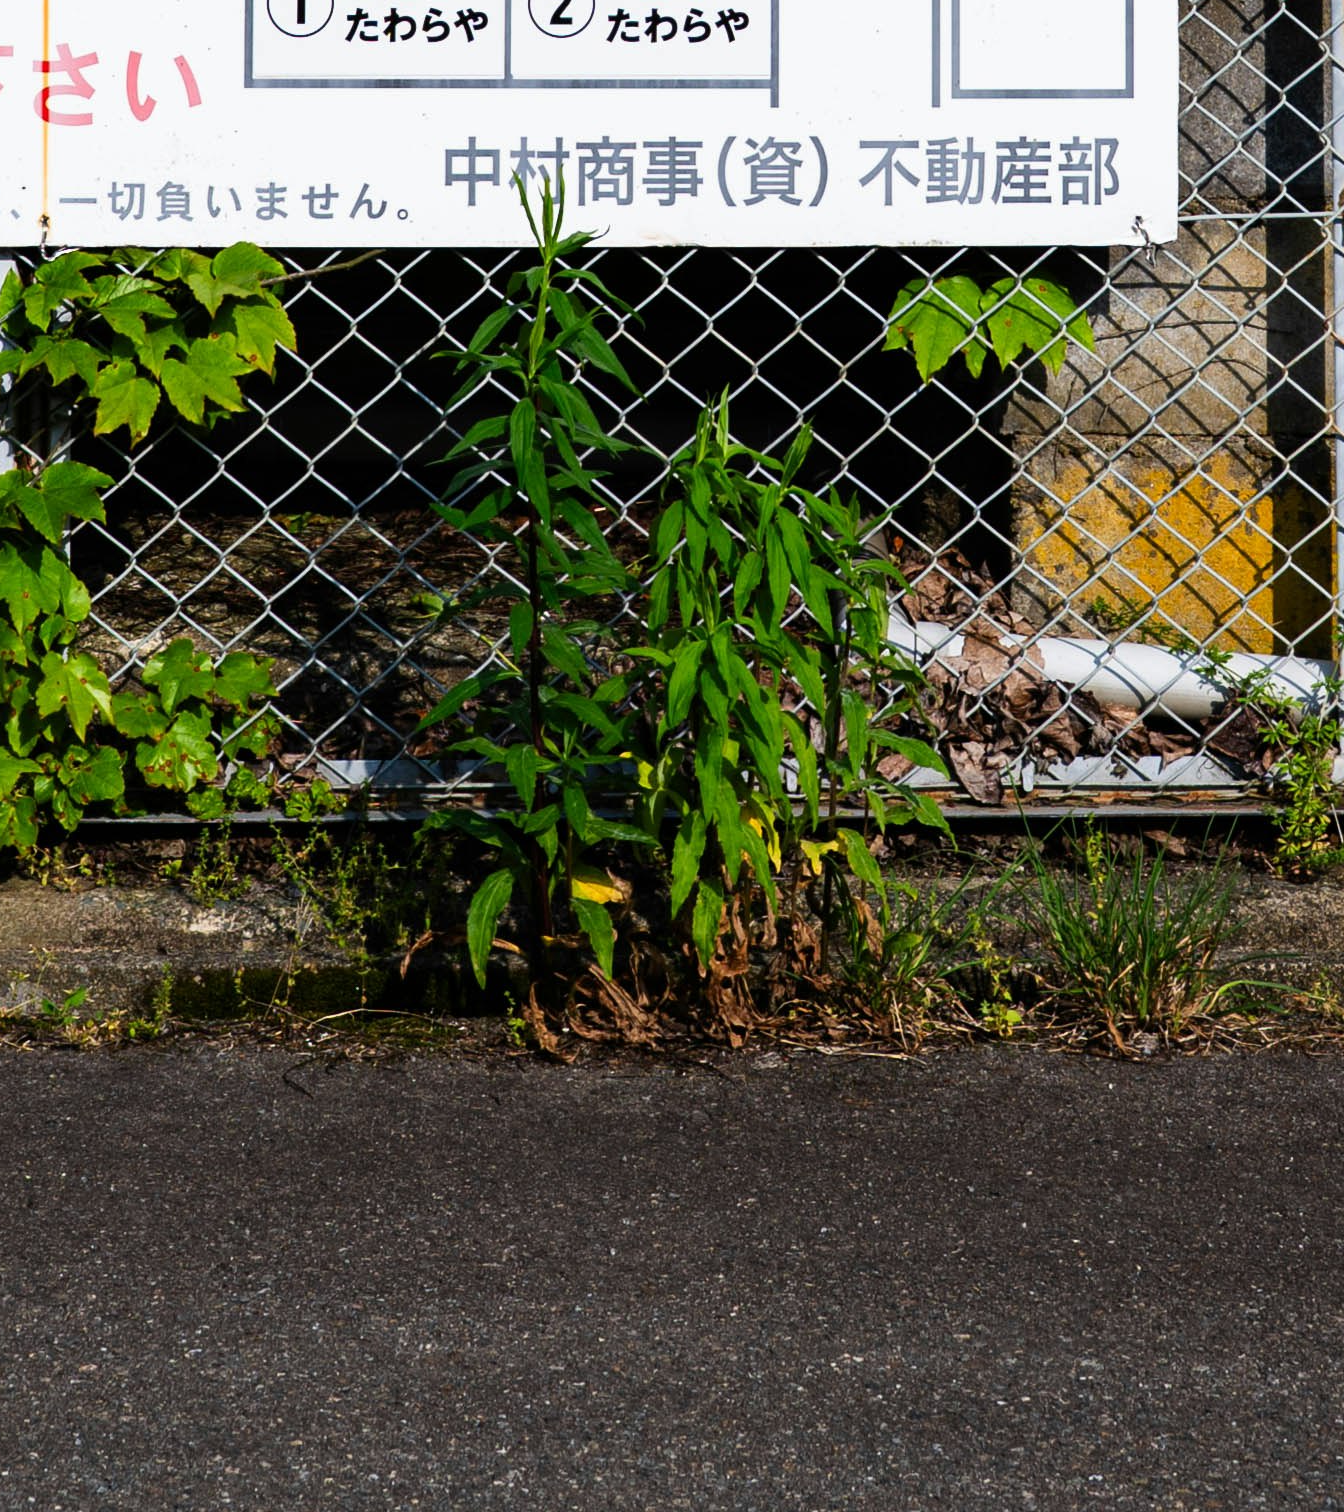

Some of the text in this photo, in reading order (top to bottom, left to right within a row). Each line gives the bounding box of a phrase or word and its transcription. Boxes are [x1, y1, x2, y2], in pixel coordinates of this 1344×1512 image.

[343, 6, 490, 44] たわらや
[604, 6, 751, 45] たわらや
[858, 134, 1121, 207] 不動産部
